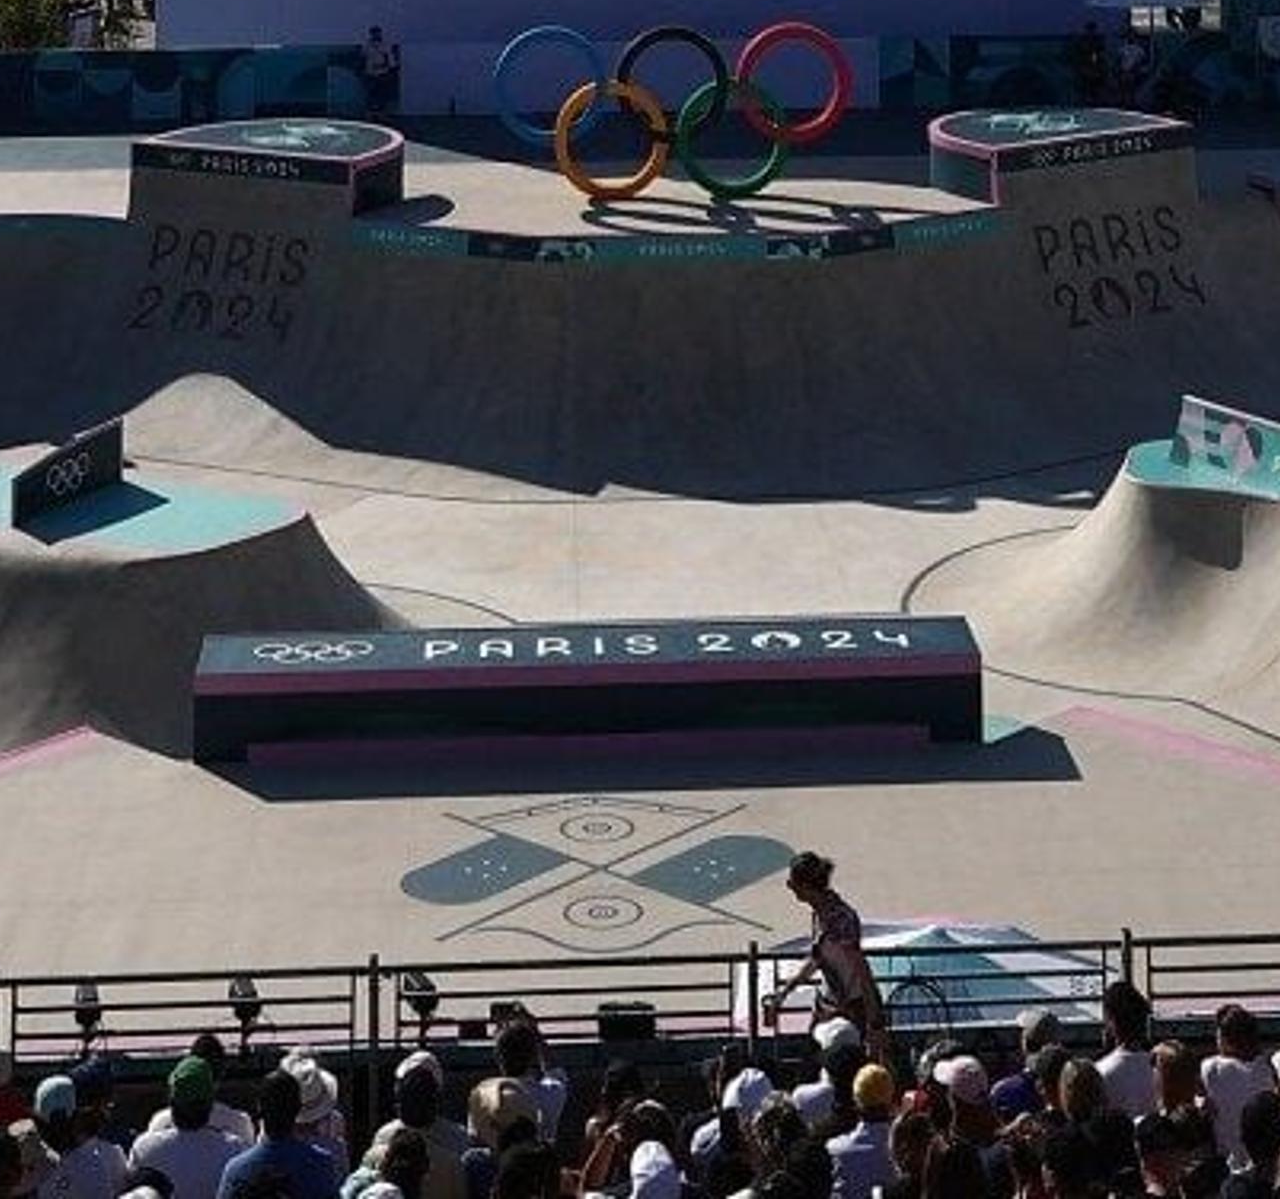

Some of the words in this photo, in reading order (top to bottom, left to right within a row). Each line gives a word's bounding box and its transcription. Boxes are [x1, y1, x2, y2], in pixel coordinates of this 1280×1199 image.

[126, 285, 294, 344] 2024
[1053, 263, 1206, 331] 2024
[695, 628, 911, 653] 2024
